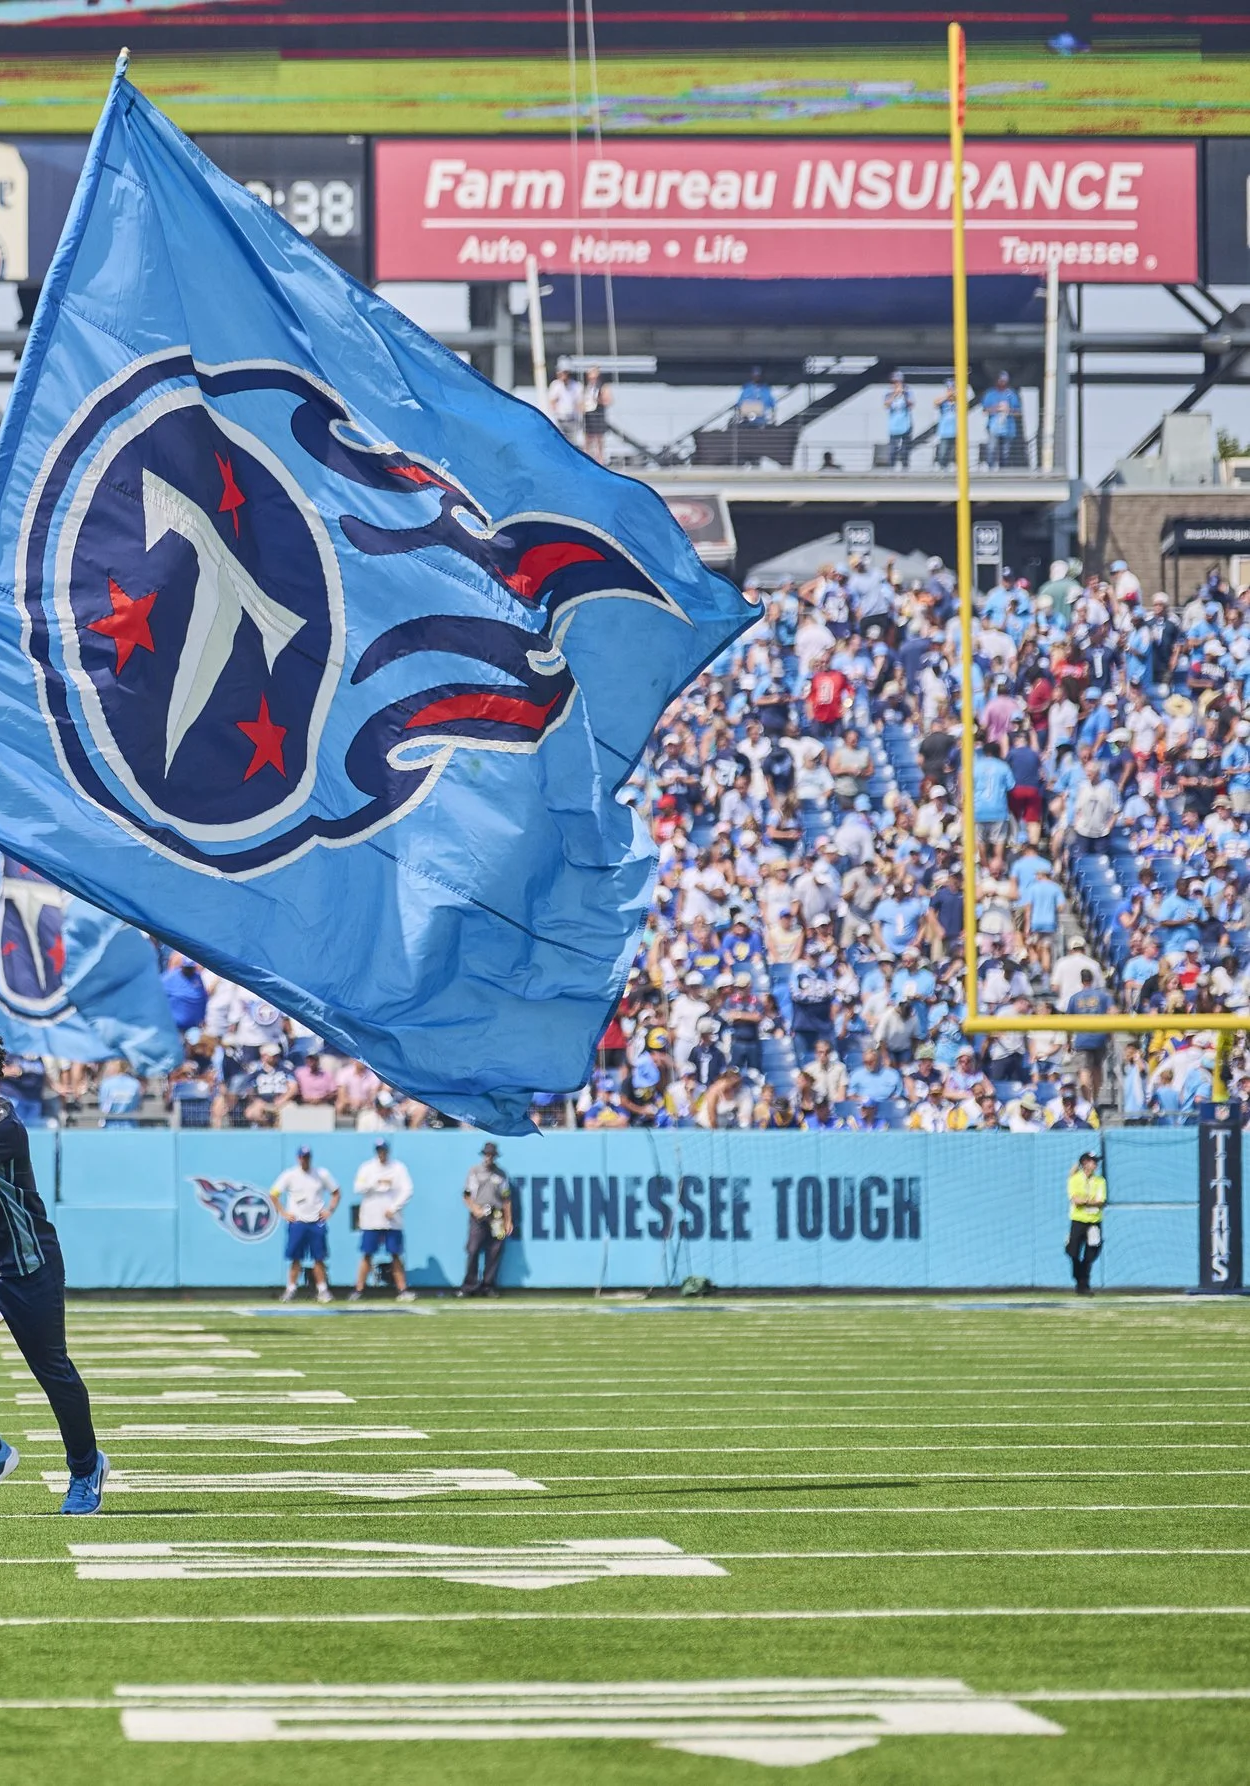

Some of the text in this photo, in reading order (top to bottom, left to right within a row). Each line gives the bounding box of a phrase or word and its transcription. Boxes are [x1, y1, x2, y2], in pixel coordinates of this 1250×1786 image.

[425, 159, 1144, 211] Farm Bureau INSURANCE
[458, 236, 748, 263] Auto Home Life
[1000, 236, 1140, 264] Tennessee
[510, 1176, 921, 1240] TENNESSEE TOUGH
[1209, 1129, 1232, 1282] TITANS
